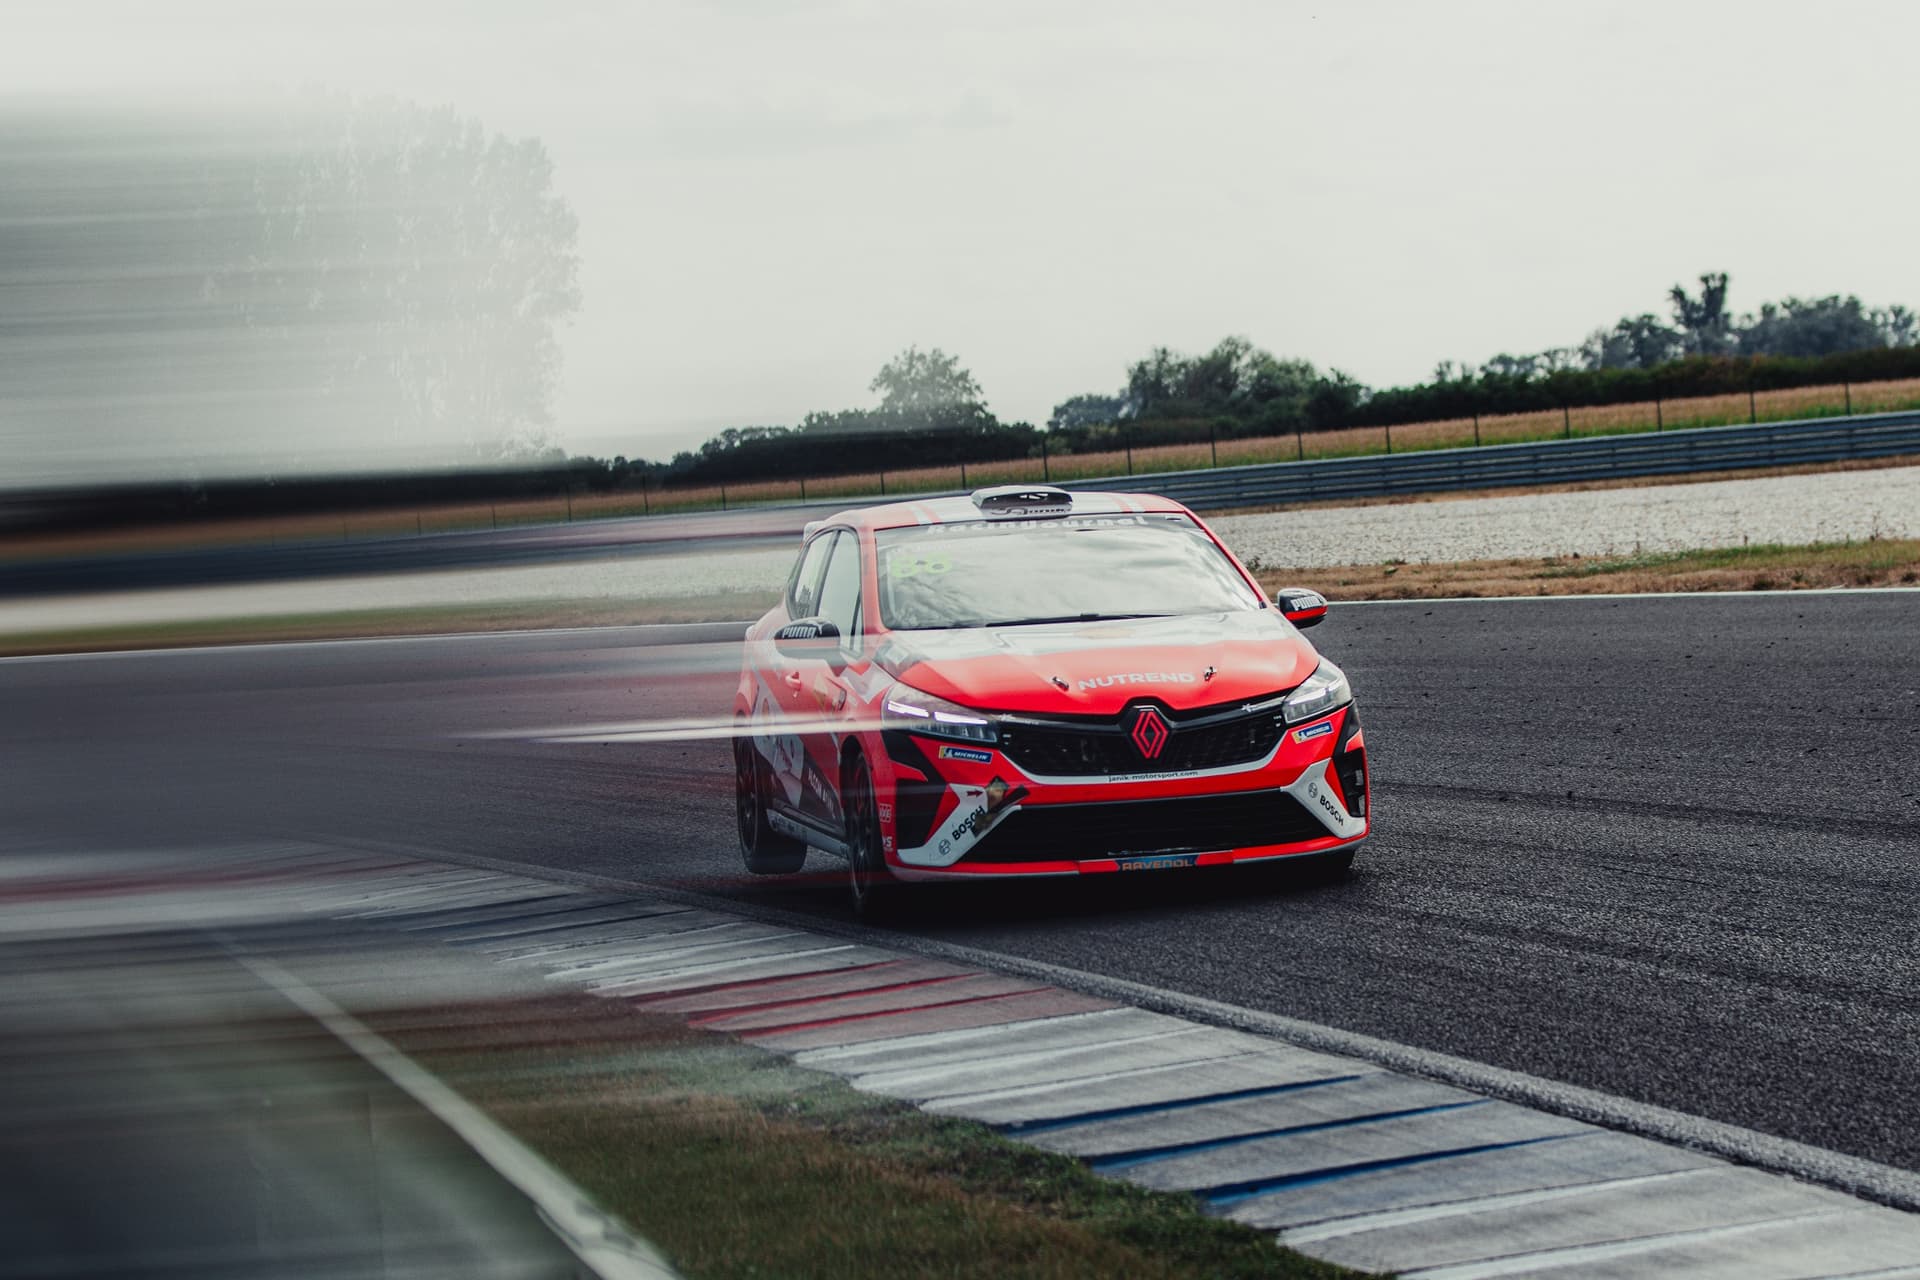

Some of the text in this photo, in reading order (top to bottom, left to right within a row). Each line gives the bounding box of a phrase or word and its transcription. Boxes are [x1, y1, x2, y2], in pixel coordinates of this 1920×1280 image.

[782, 626, 817, 639] PUMA
[1078, 672, 1196, 690] NUTREND
[953, 751, 988, 761] MICHELIN
[1108, 771, 1199, 782] janik-motorsport.com
[1320, 795, 1344, 826] BOSCH
[1122, 859, 1194, 871] RAVENOL
